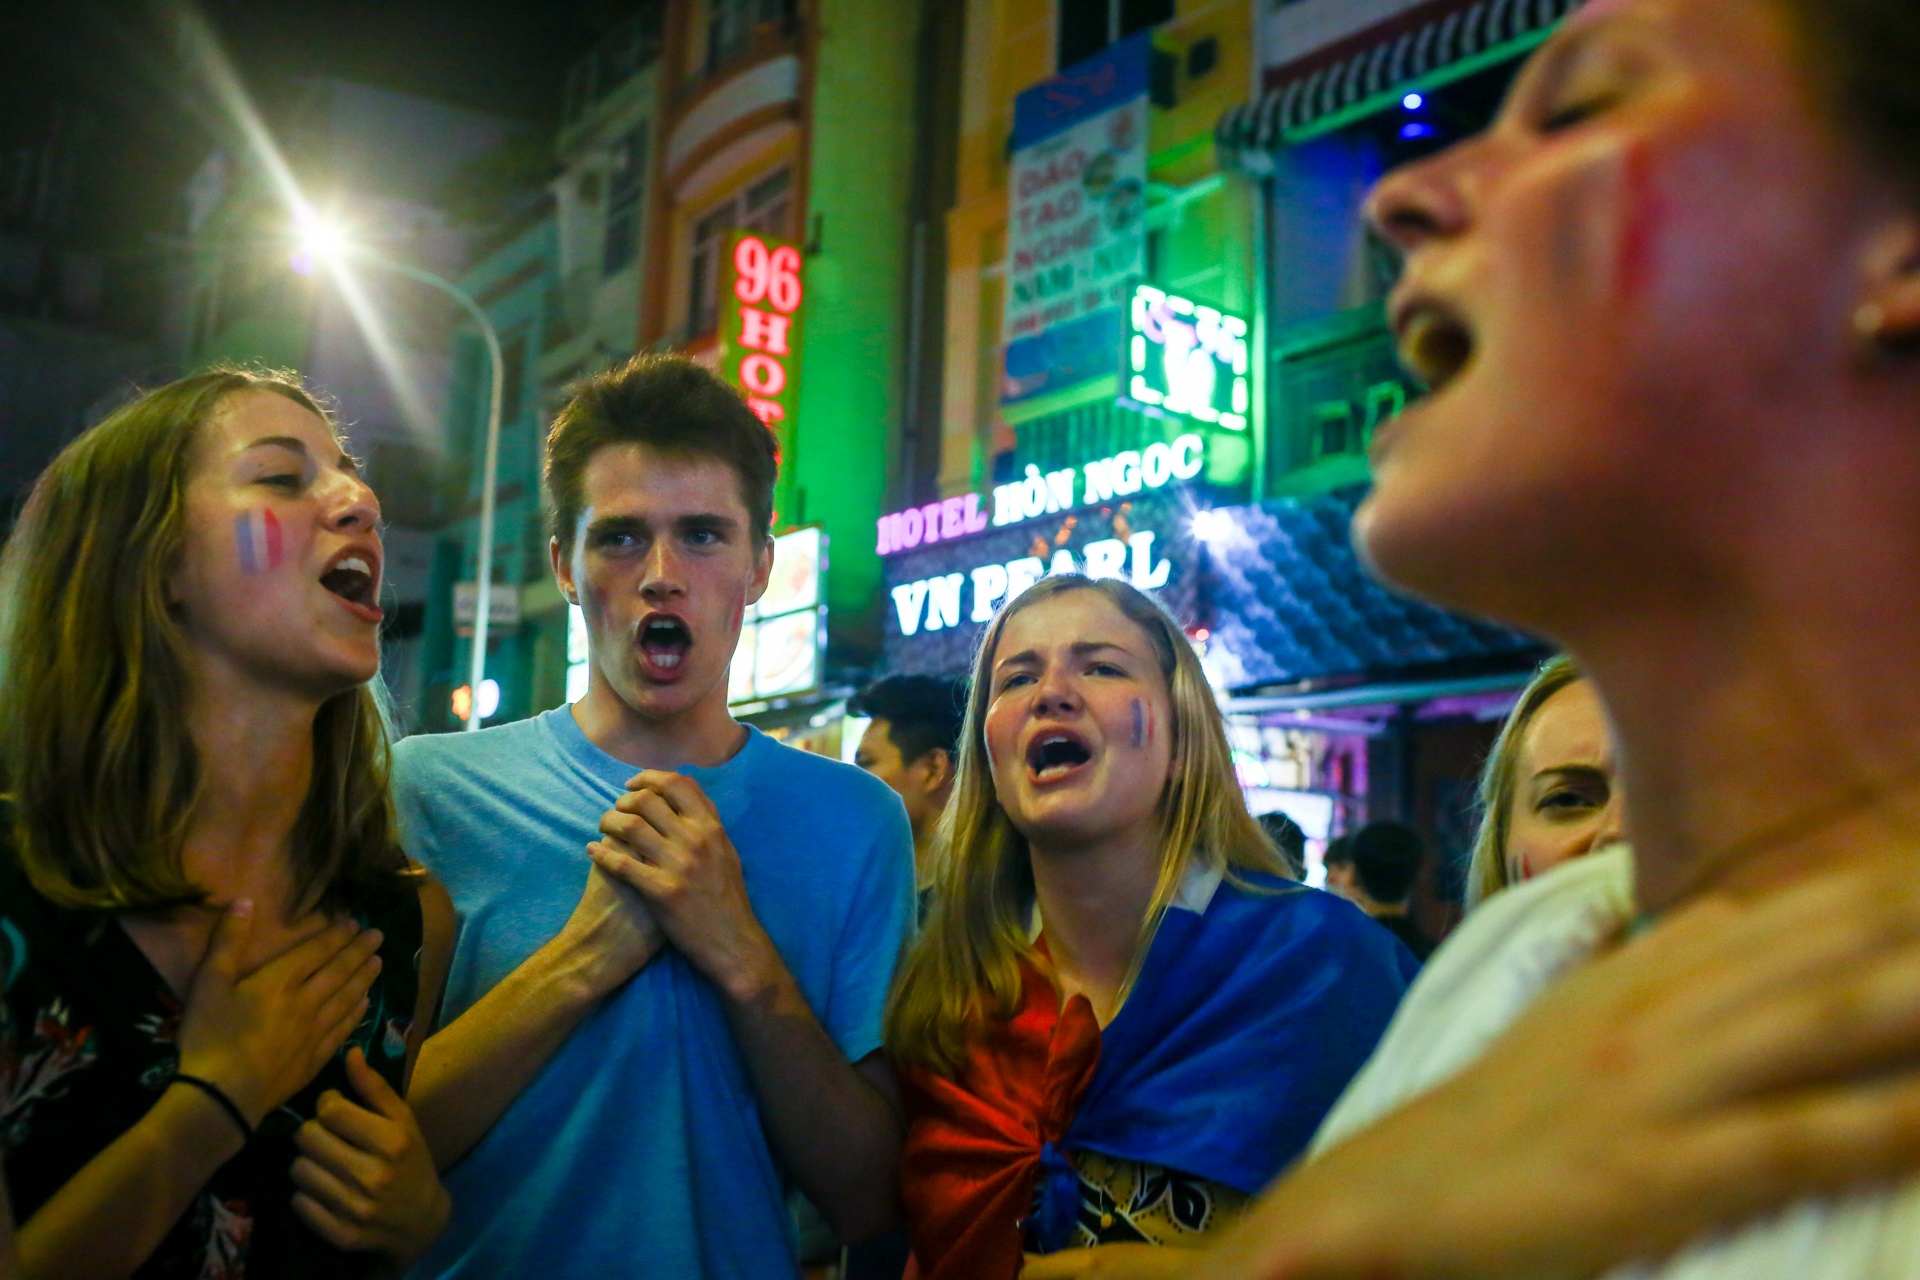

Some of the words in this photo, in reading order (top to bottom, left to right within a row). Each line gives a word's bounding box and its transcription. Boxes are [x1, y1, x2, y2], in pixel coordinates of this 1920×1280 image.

[734, 236, 803, 314] 96
[737, 305, 793, 466] HOT
[876, 493, 988, 556] HOTEL
[891, 572, 964, 636] VN
